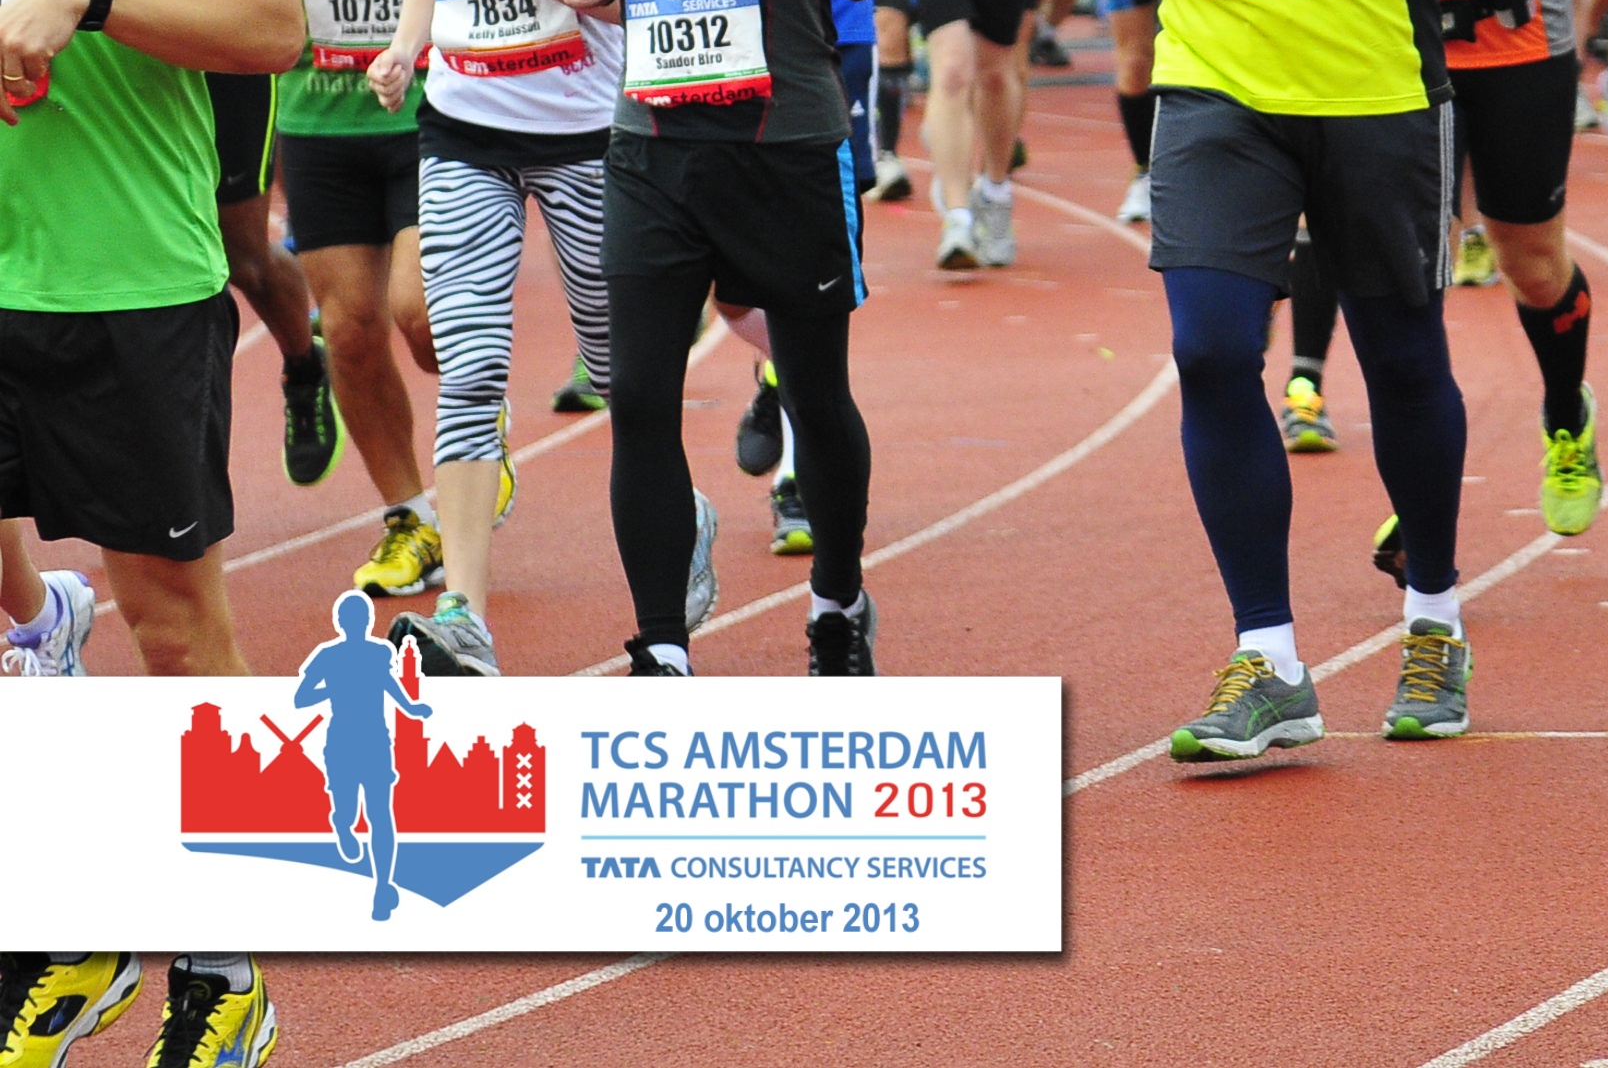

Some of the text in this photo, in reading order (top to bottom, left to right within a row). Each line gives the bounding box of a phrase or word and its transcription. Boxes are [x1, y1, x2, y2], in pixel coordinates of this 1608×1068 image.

[628, 1, 659, 18] TATA
[467, 25, 495, 40] Kelly
[646, 13, 732, 55] 10312
[655, 52, 723, 70] Sandor Biro
